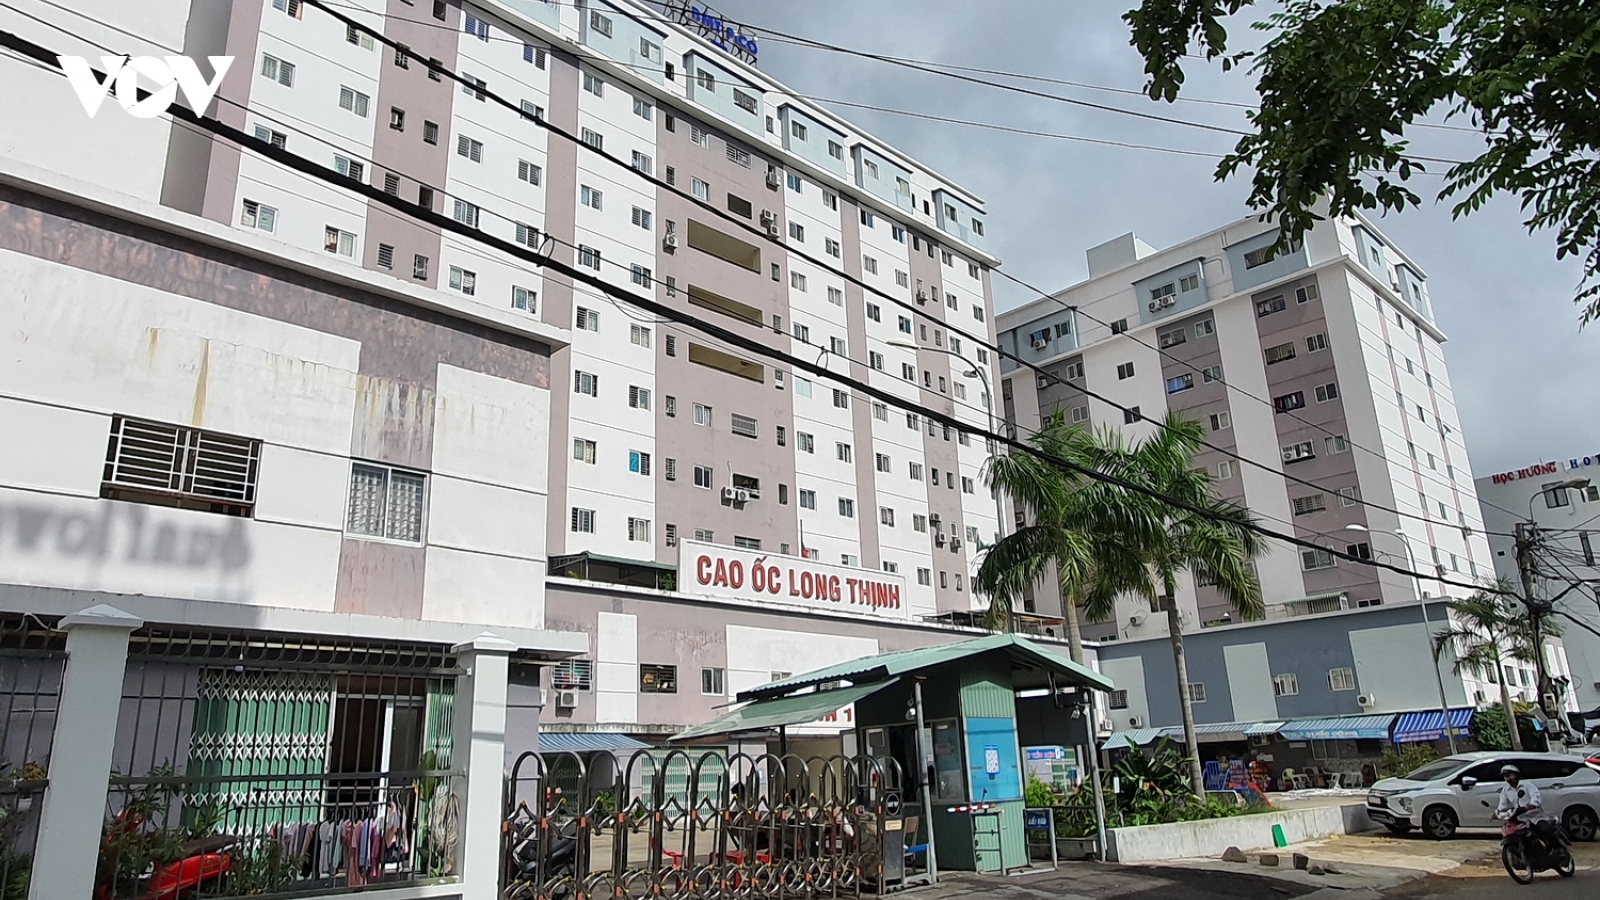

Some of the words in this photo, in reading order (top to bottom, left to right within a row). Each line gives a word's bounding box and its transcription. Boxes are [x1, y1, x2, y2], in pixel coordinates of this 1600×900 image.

[1492, 471, 1514, 485] HỌC
[697, 555, 744, 589] CAO
[751, 556, 781, 594] ỐC
[789, 569, 841, 602] LONG
[846, 577, 900, 611] THỊNH
